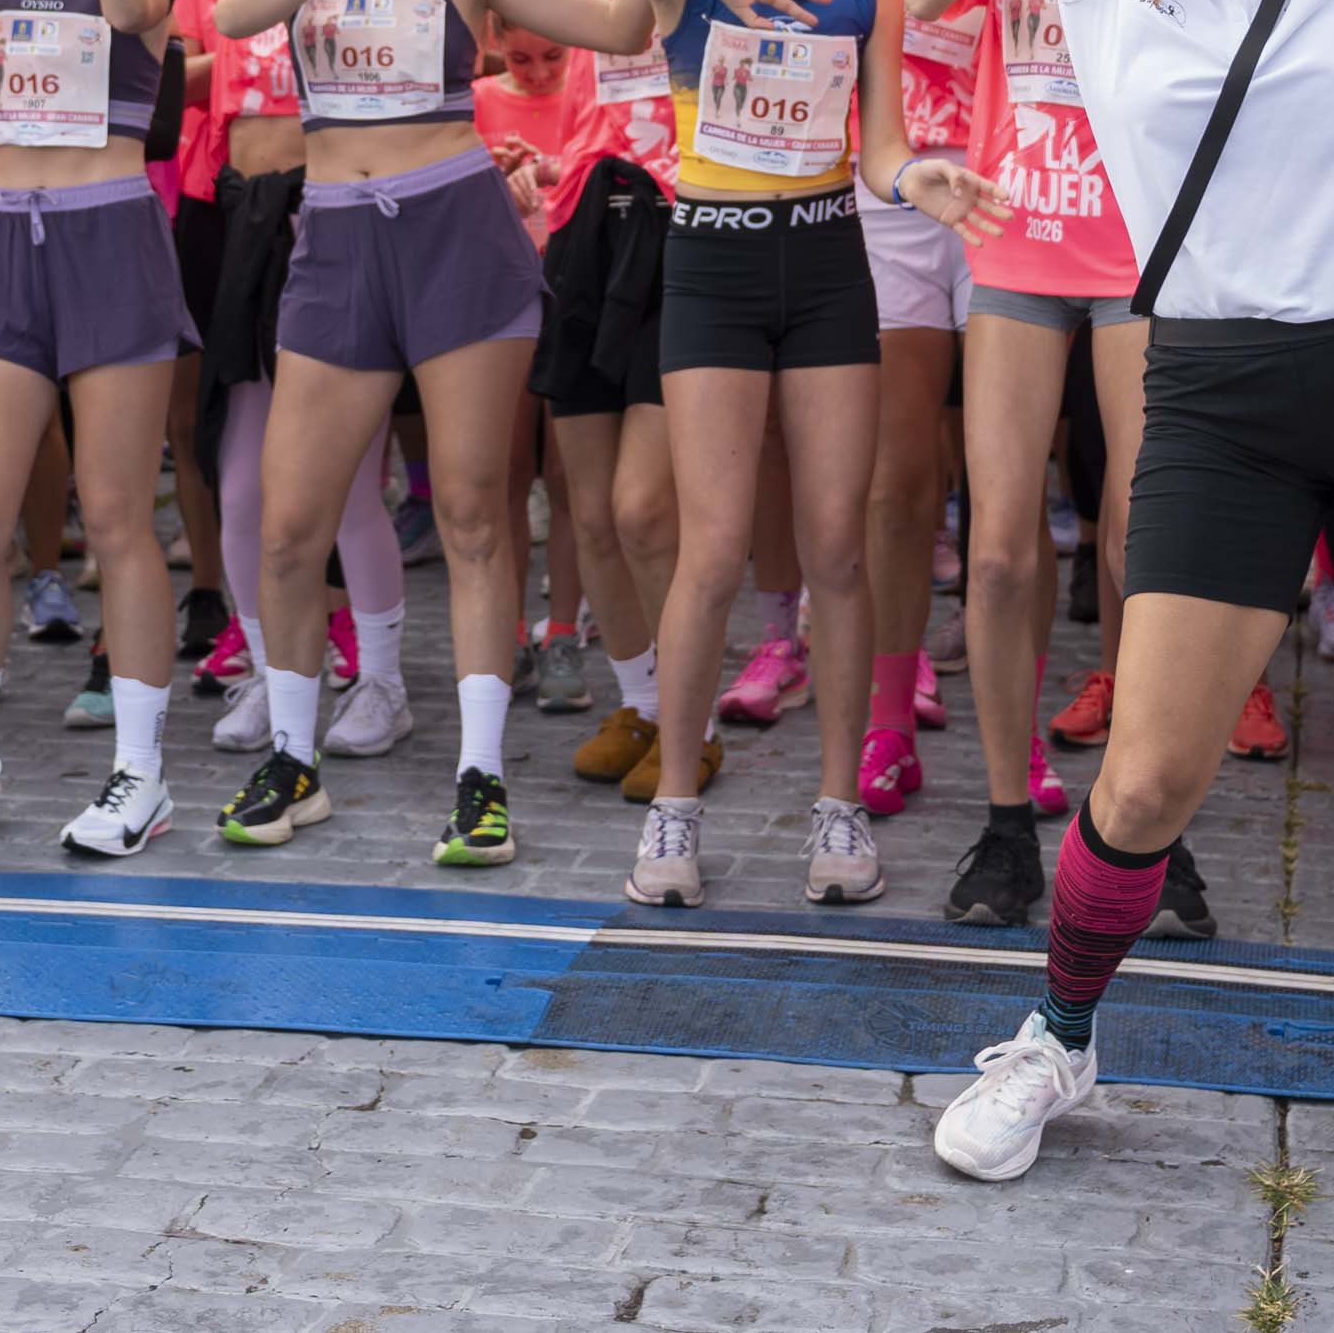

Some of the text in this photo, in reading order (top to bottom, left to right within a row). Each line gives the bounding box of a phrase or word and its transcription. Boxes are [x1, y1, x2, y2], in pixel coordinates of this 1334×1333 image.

[342, 45, 394, 68] 016
[9, 73, 60, 94] 016
[751, 96, 809, 123] 016
[770, 125, 785, 137] 89
[691, 207, 773, 230] PRO
[789, 193, 857, 227] NIKE
[1026, 216, 1063, 243] 2026
